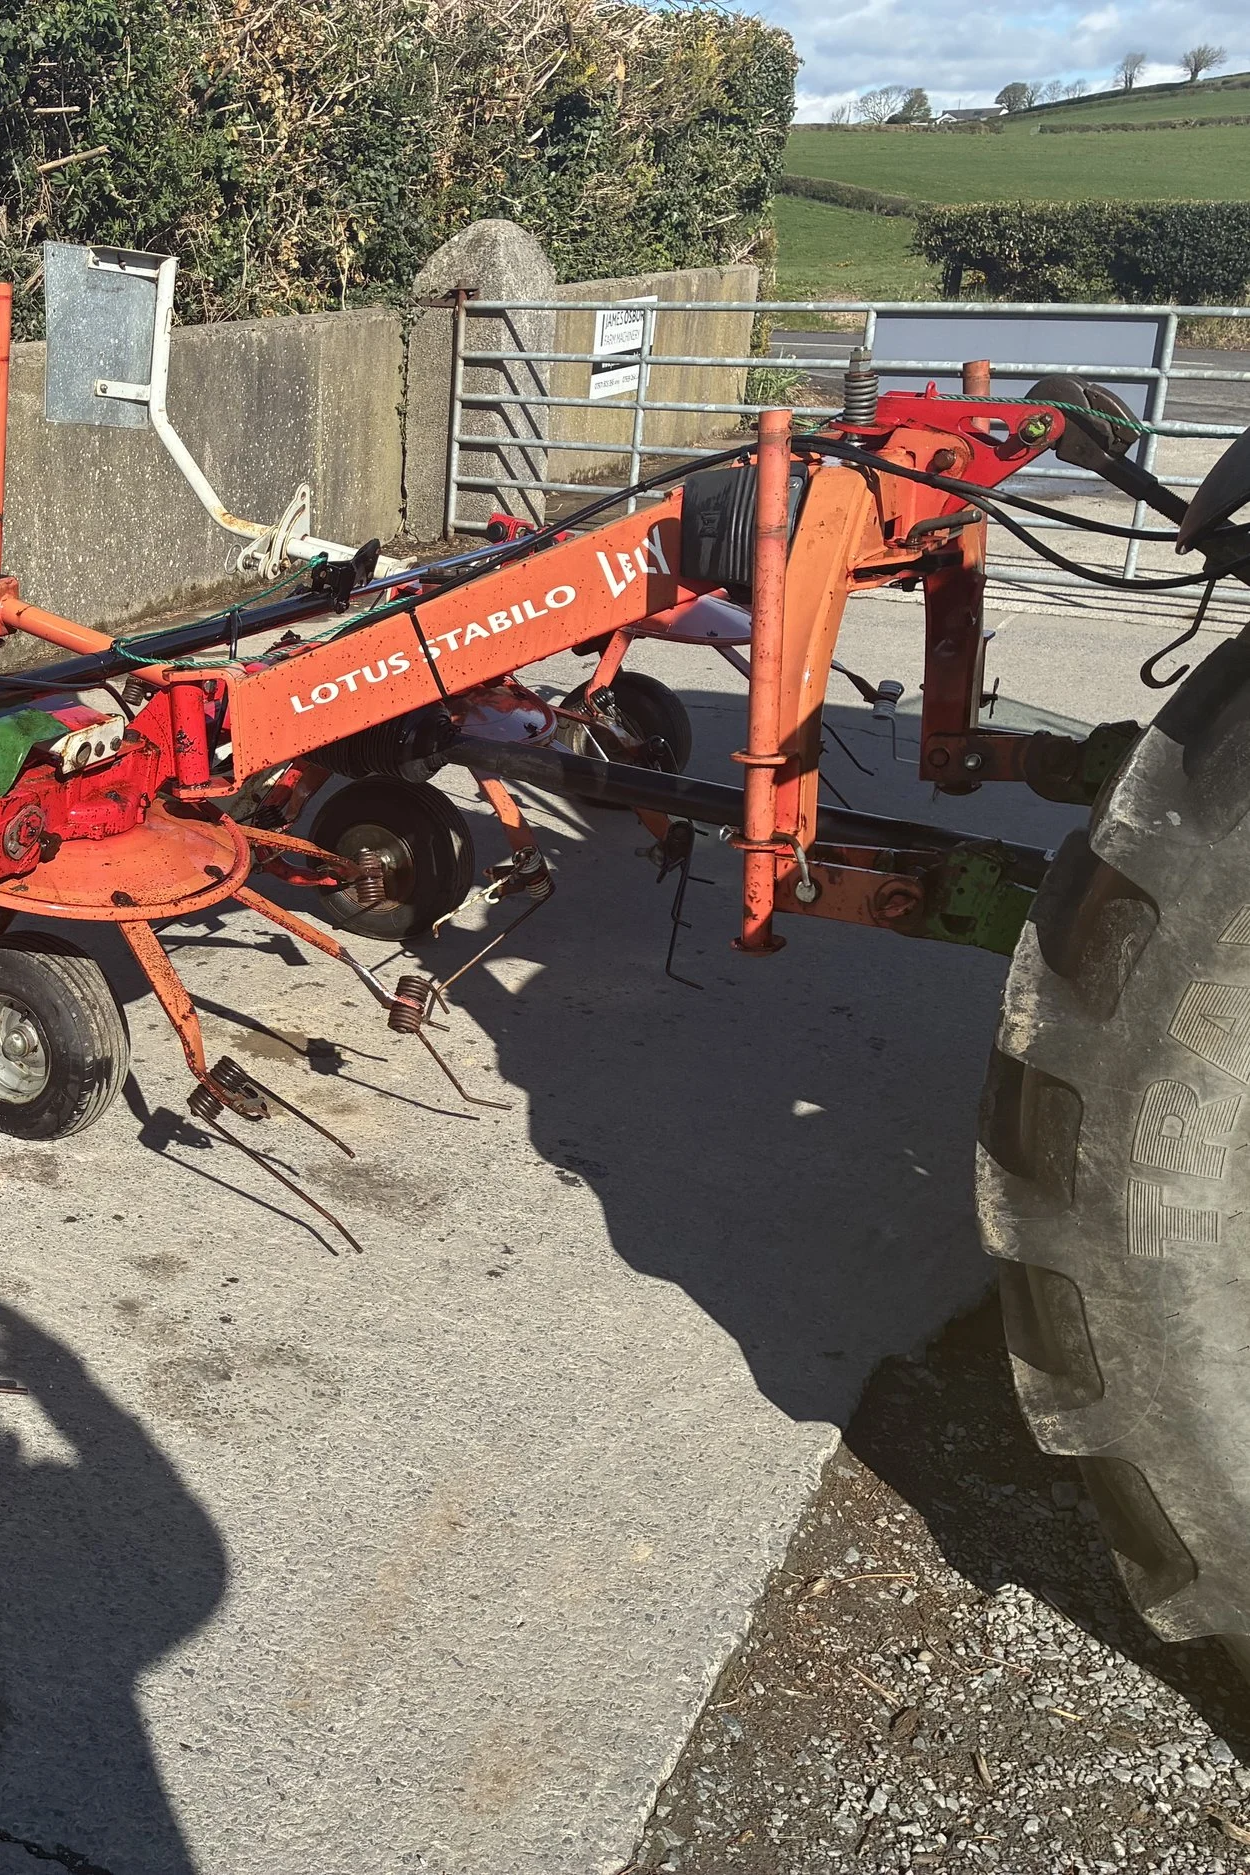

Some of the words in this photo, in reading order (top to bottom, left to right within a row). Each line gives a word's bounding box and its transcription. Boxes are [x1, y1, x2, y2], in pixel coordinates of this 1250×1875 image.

[595, 524, 671, 599] LELY
[290, 651, 411, 715] LOTUS
[422, 585, 576, 664] STABILO
[1126, 904, 1250, 1257] TRA
